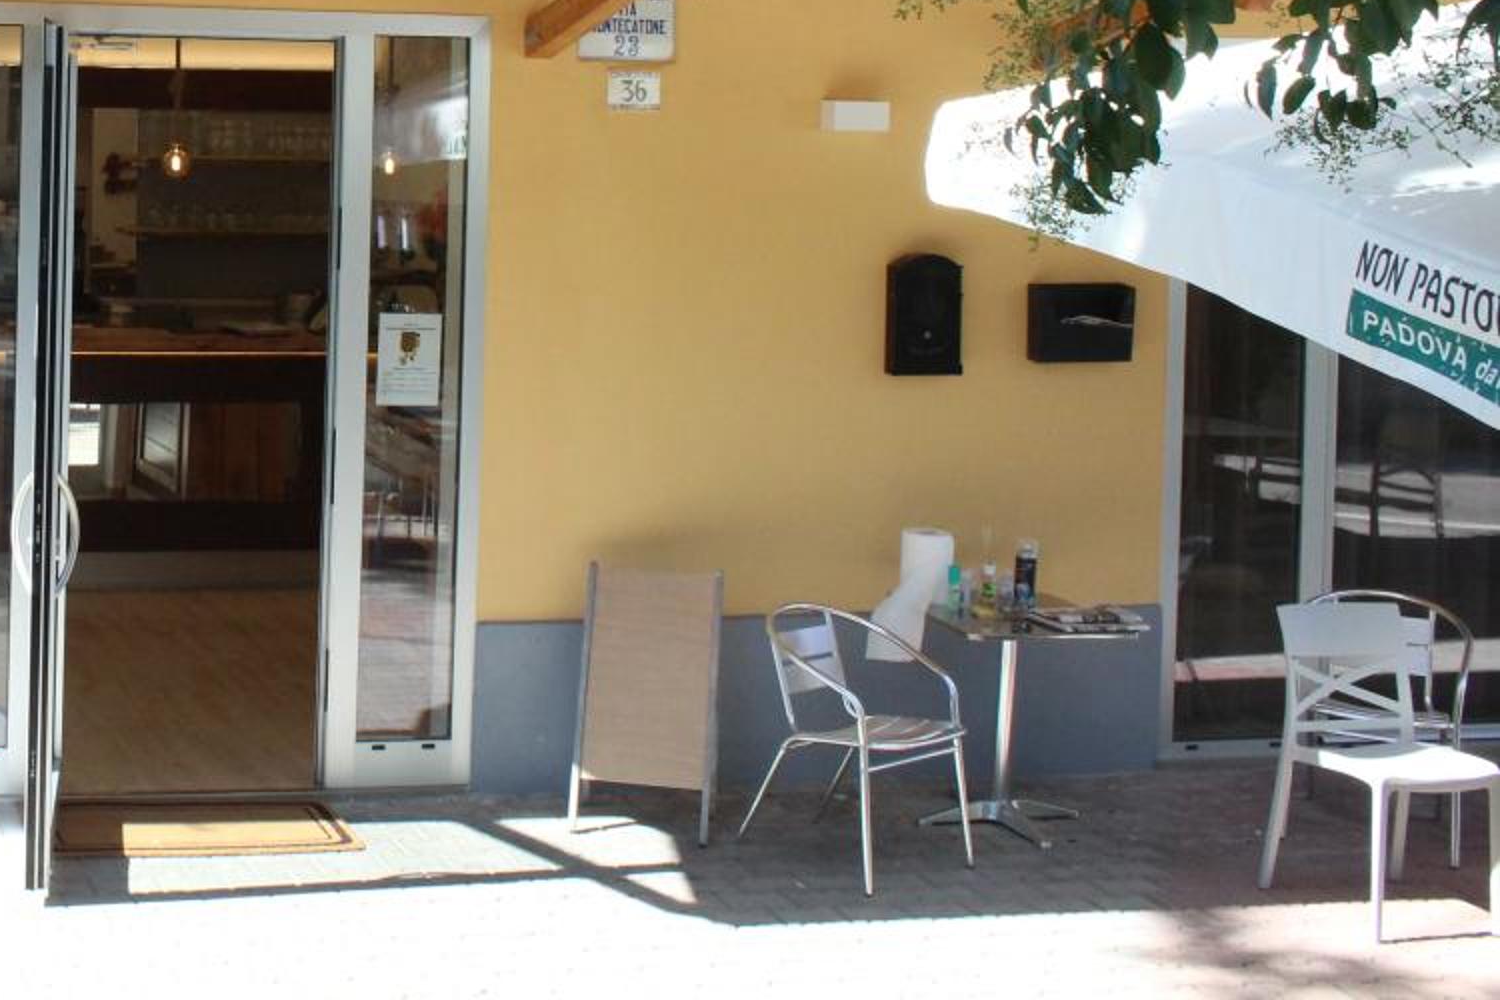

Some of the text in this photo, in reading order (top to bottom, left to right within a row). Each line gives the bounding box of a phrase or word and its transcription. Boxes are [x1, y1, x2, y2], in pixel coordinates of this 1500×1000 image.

[620, 79, 648, 102] 36
[1355, 239, 1409, 297] NON
[1362, 309, 1468, 372] PADOVA
